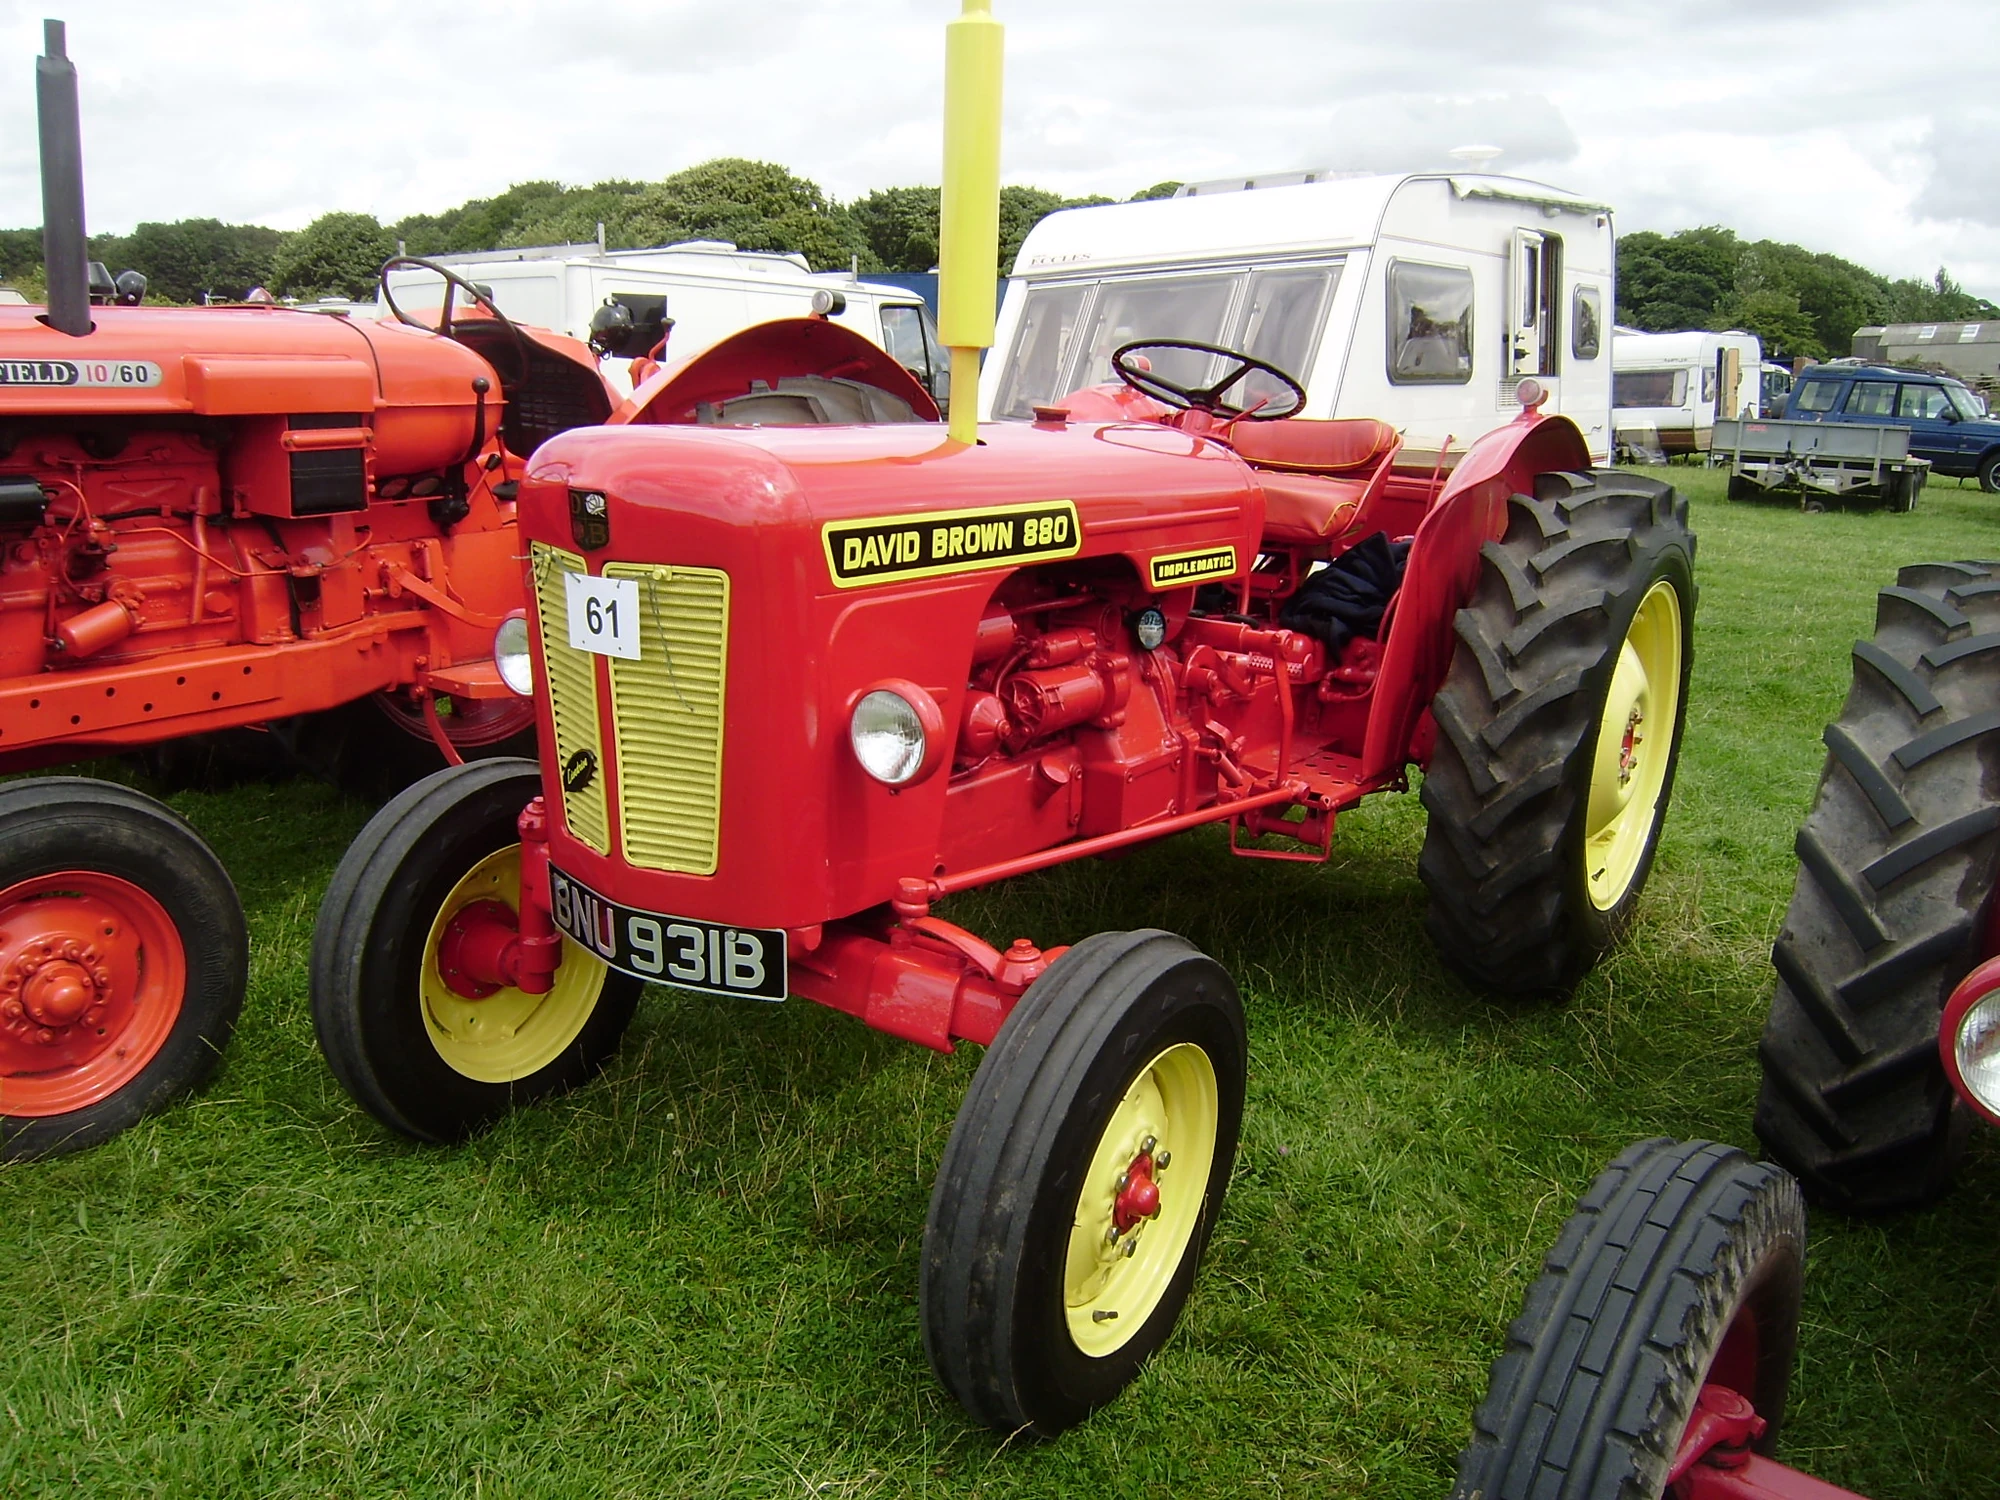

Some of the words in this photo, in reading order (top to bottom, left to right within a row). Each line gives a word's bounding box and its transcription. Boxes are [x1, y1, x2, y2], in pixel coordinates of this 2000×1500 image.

[86, 364, 148, 382] 10/60
[843, 531, 920, 571] DAVID
[931, 521, 1014, 559] BROWN
[1023, 515, 1069, 547] 880
[1158, 555, 1232, 578] IMPLEMATIC
[586, 596, 619, 638] 61
[553, 872, 616, 959] BNU
[628, 916, 765, 989] 931B
